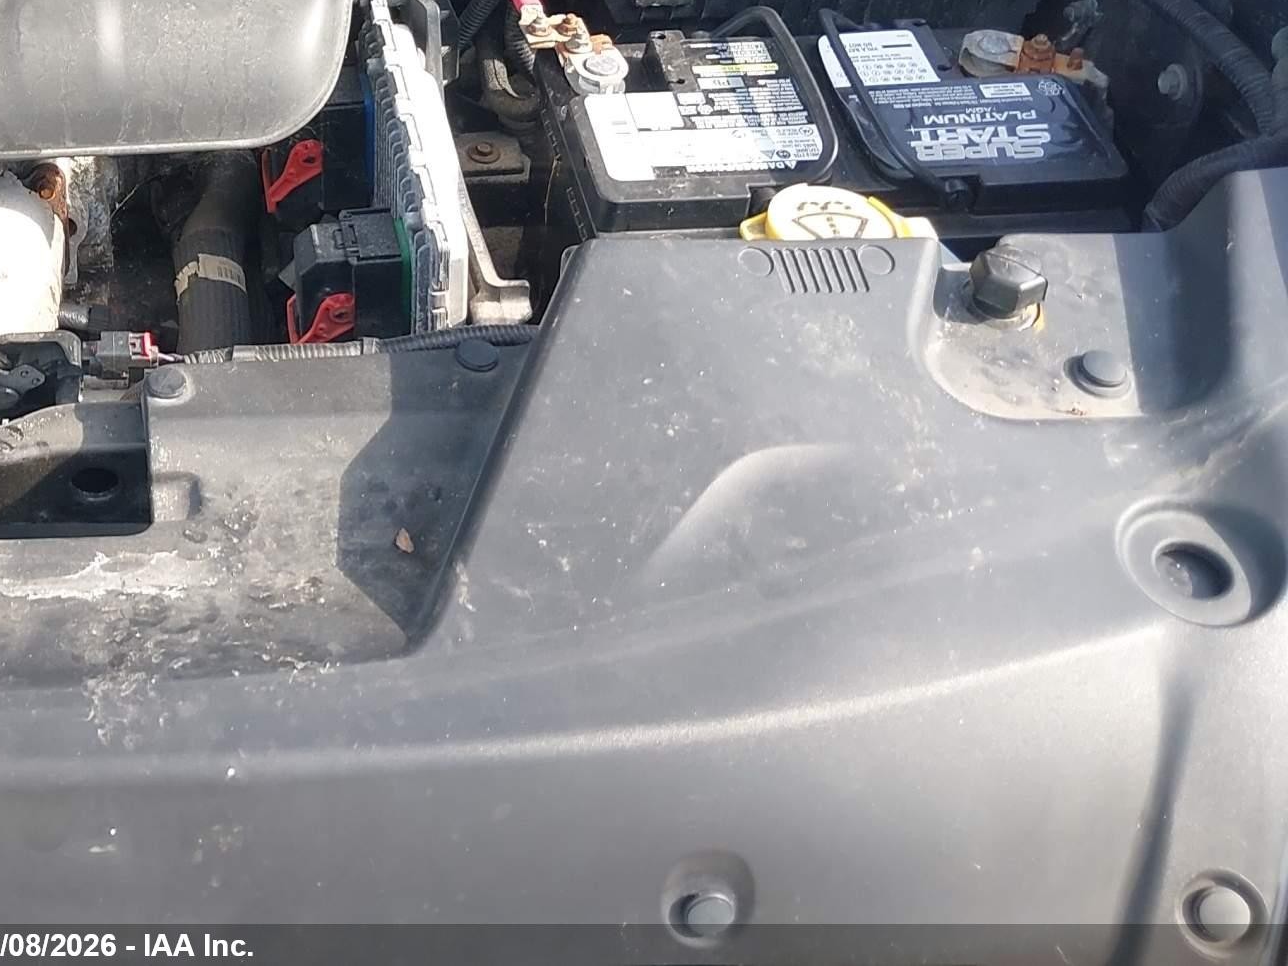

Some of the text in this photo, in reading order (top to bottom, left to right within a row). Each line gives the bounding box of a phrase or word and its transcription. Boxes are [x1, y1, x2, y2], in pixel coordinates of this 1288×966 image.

[923, 109, 1037, 125] PLATINUM
[911, 124, 1051, 146] START
[916, 141, 1045, 162] SUPER
